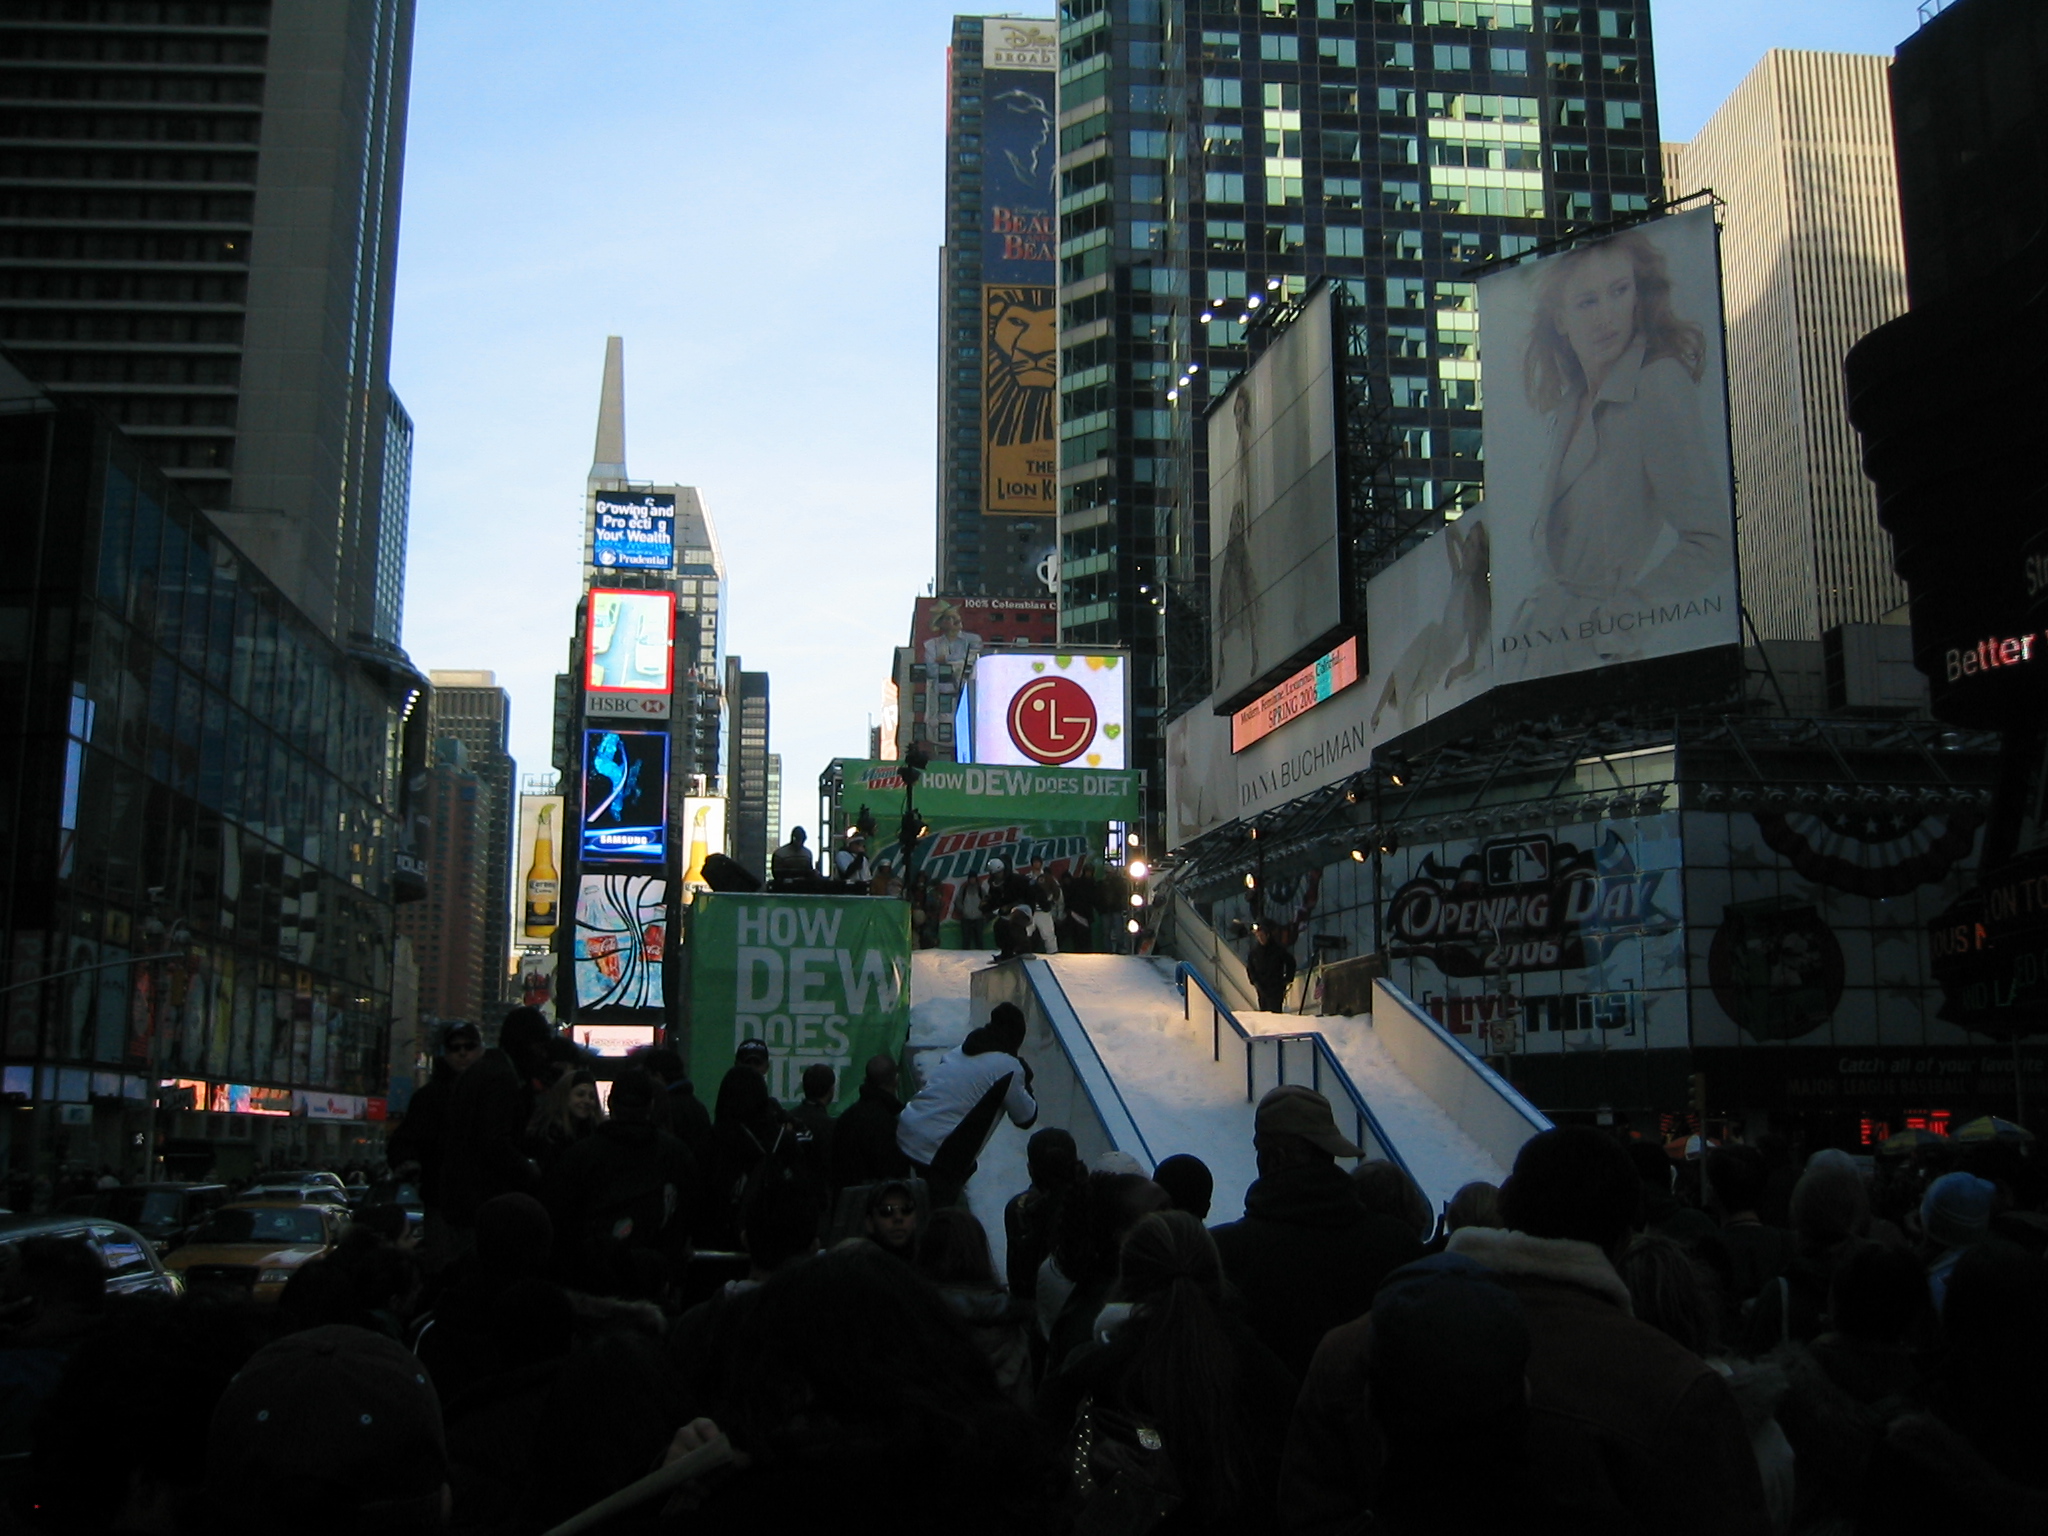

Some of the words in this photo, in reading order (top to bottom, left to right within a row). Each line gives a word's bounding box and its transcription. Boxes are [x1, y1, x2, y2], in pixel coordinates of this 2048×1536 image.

[994, 52, 1056, 63] BROAD
[1003, 234, 1056, 261] BEA
[1025, 460, 1054, 474] THE
[997, 477, 1037, 500] LION
[649, 504, 674, 517] and
[596, 528, 624, 541] Your
[626, 529, 671, 544] Wealth
[619, 554, 668, 565] Prudential
[965, 599, 989, 608] 100%
[991, 600, 1046, 610] Colombian
[1579, 596, 1722, 640] BUCHMAN
[1945, 632, 2038, 683] Better
[591, 697, 638, 713] HSBC
[1014, 681, 1092, 758] LG
[1281, 720, 1365, 789] BUCHMAN
[922, 772, 964, 790] HOW
[966, 768, 1032, 796] DEW
[1035, 777, 1079, 794] DOES
[1083, 775, 1131, 796] DIET
[600, 834, 648, 845] SAMSUNG
[931, 827, 1021, 857] Diet
[736, 905, 844, 947] HOW
[1483, 940, 1561, 969] 2006
[735, 946, 906, 1015] DEW
[734, 1014, 850, 1057] DOES
[764, 1056, 852, 1104] IET
[1838, 1057, 1885, 1074] Catch
[1890, 1057, 1911, 1073] all
[1914, 1057, 1936, 1073] of
[1938, 1059, 1975, 1077] your
[1980, 1057, 2045, 1074] favoite
[1843, 1078, 1896, 1095] LEAGUE
[1900, 1077, 1969, 1096] BASEBALL
